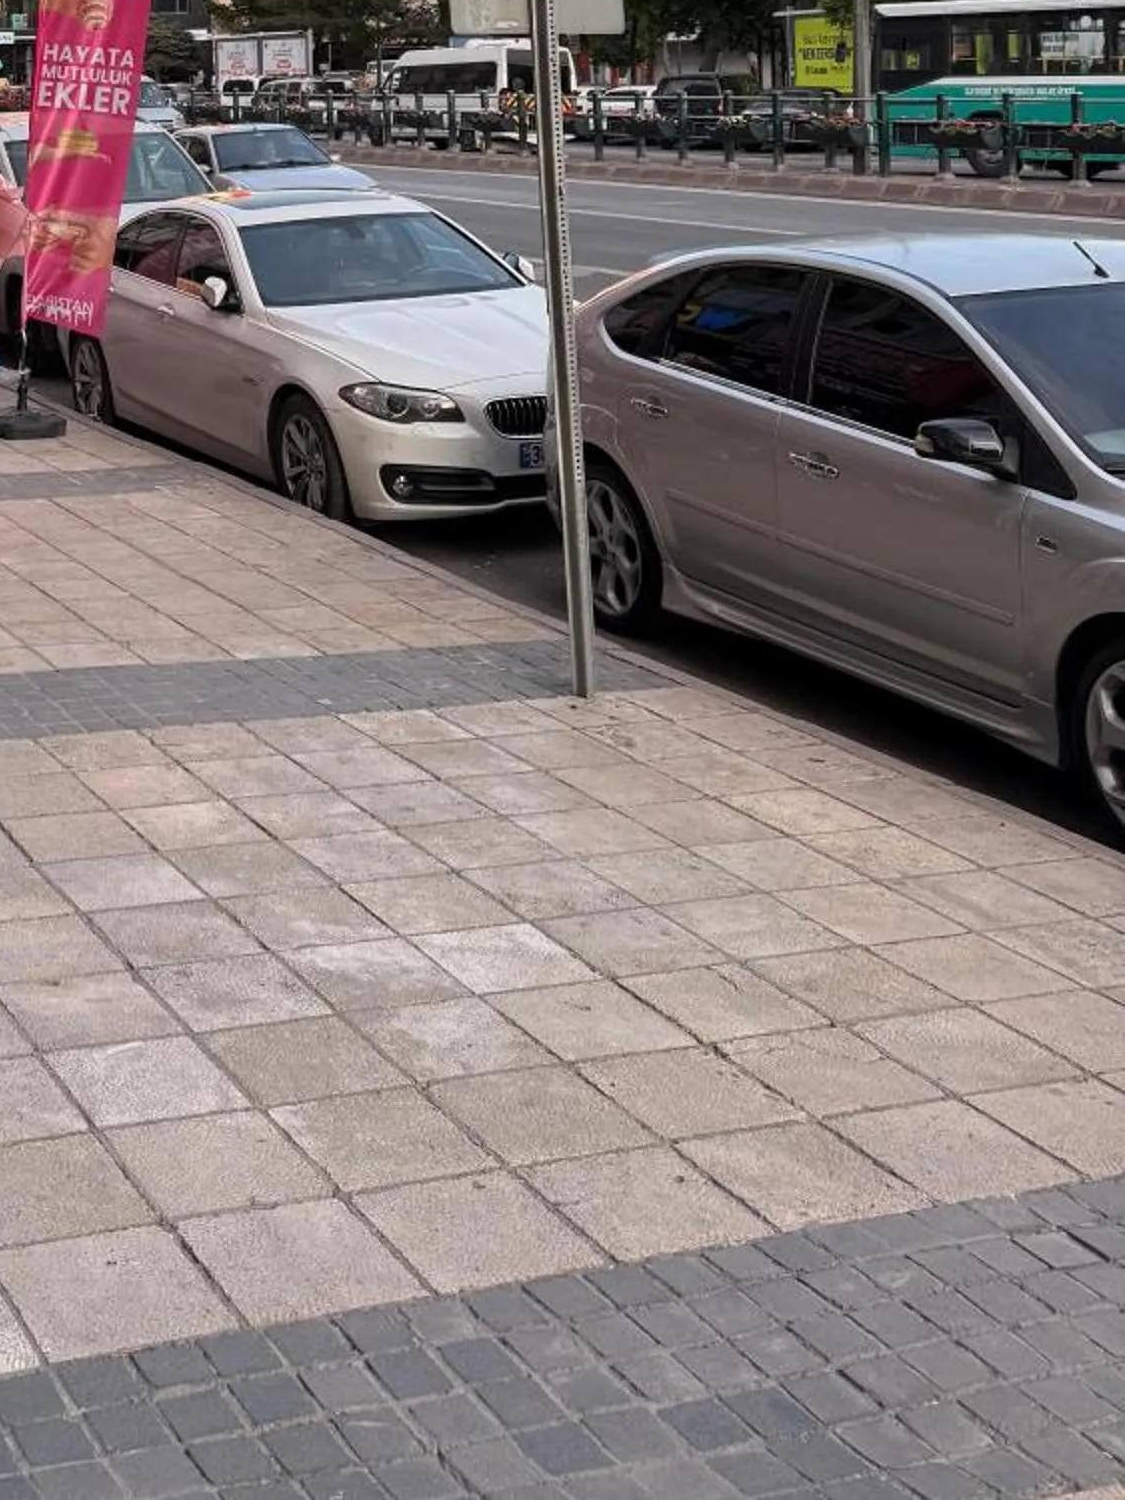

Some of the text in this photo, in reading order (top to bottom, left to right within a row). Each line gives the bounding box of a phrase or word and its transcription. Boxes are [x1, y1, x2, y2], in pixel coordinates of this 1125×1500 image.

[43, 43, 134, 69] HAYATA
[41, 63, 133, 85] MUTLULUK
[37, 81, 131, 117] EKLER
